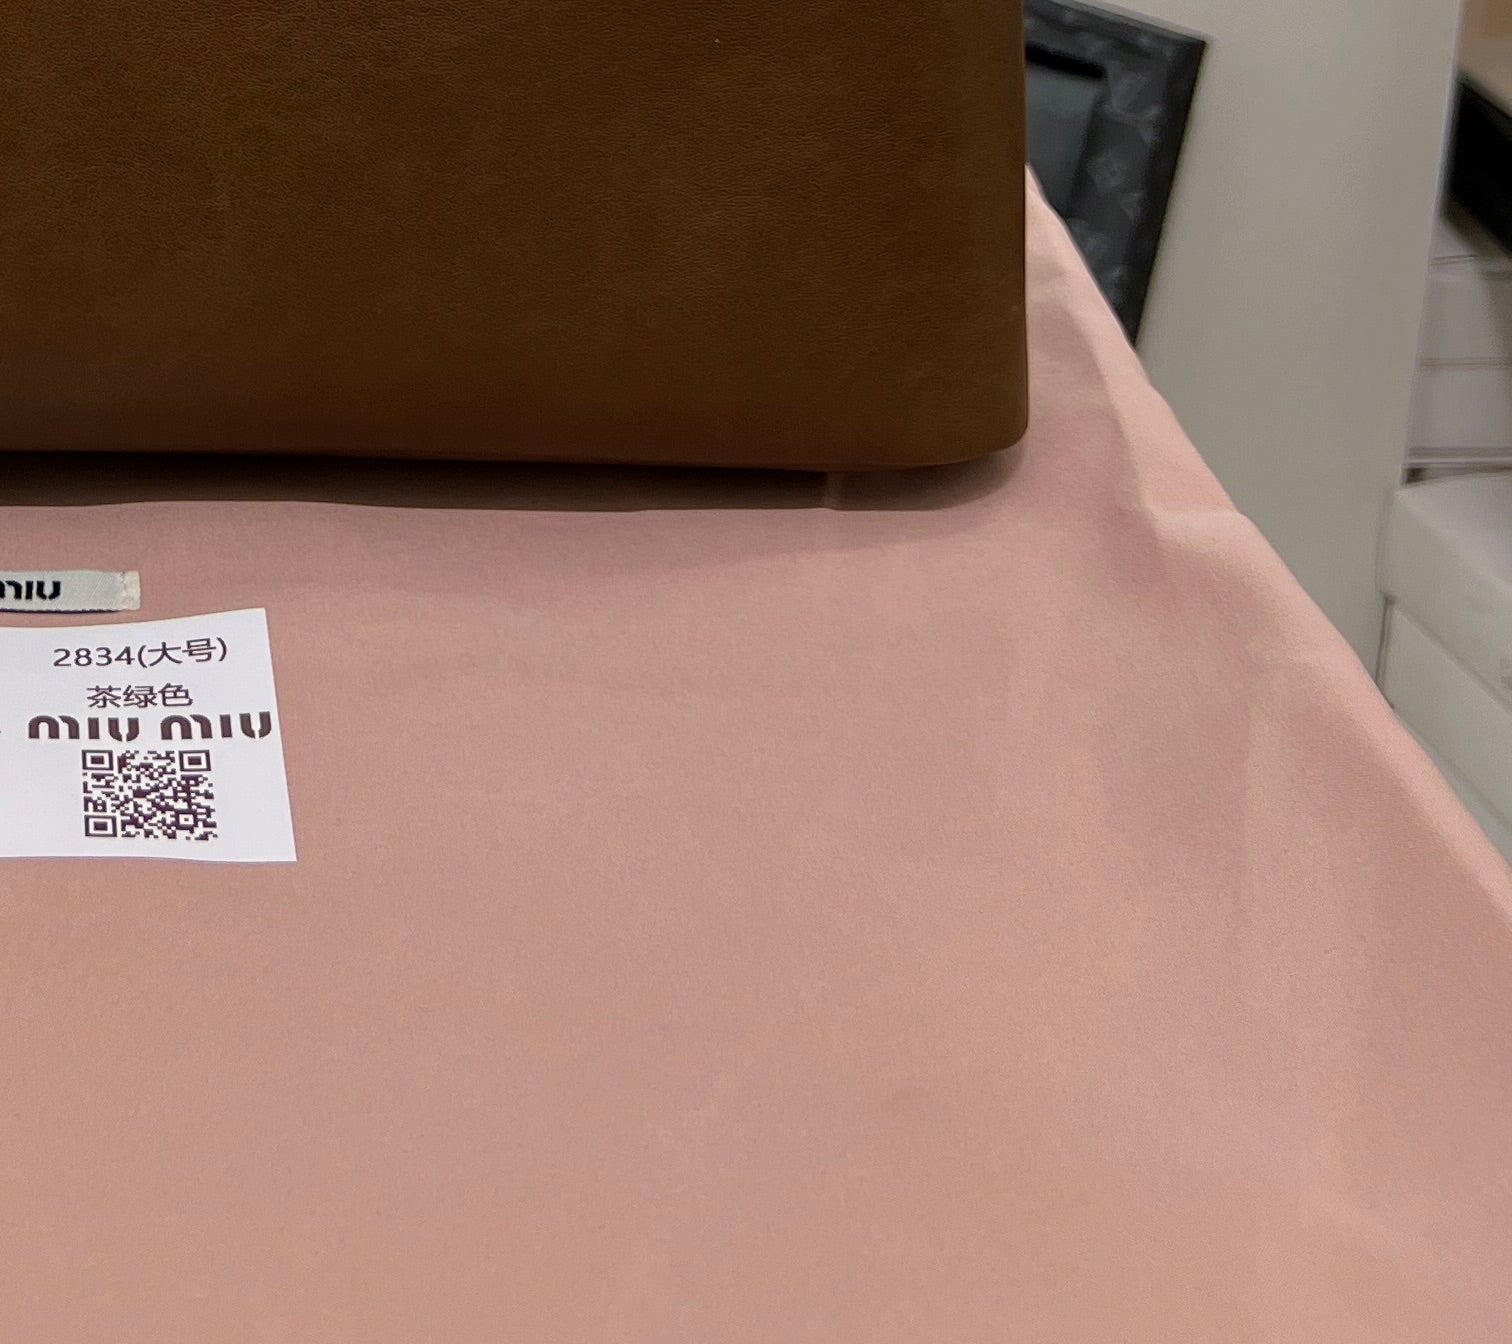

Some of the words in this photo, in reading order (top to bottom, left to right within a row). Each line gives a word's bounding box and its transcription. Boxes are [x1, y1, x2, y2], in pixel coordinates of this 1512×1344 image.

[53, 637, 228, 668] 2834(大号)
[86, 683, 194, 708] 茶绿色
